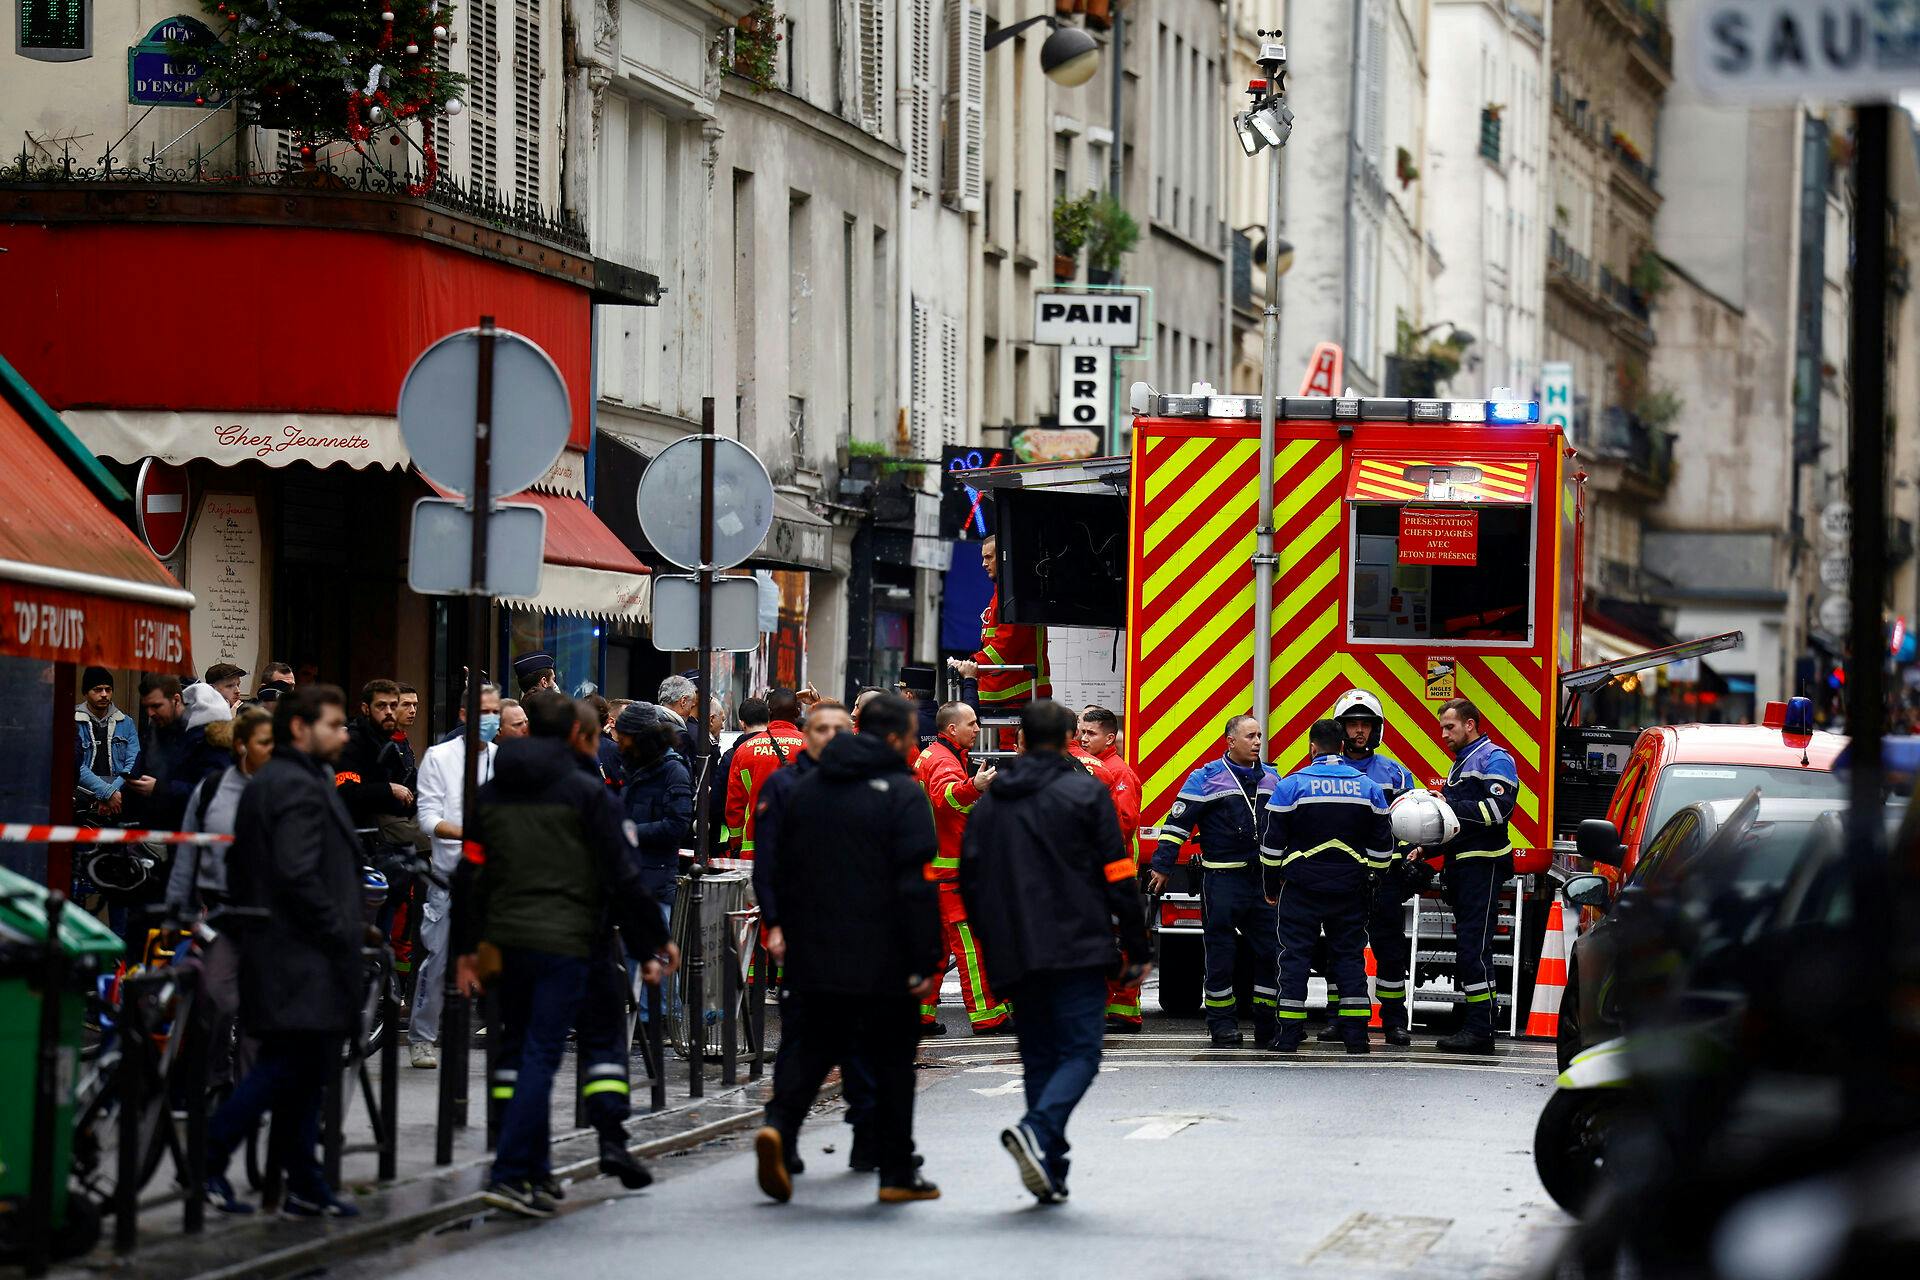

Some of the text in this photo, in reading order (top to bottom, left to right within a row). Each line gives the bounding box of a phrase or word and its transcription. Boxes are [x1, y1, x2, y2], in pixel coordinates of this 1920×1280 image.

[1041, 303, 1133, 324] PAIN
[1088, 337, 1102, 346] LA
[1073, 356, 1097, 423] BRO
[214, 425, 370, 457] Chez Jeannette
[1404, 516, 1473, 527] PRÉSENTATION
[1404, 528, 1473, 538] CHEFS D'AGRÈS
[1427, 540, 1450, 548] AVEC
[1399, 550, 1477, 560] JETON DE PRÉSENCE
[40, 604, 84, 650] FRUITS
[746, 737, 771, 748] SAPEURS
[753, 745, 790, 756] PARS
[1310, 779, 1362, 796] POLICE
[1515, 849, 1527, 857] 32
